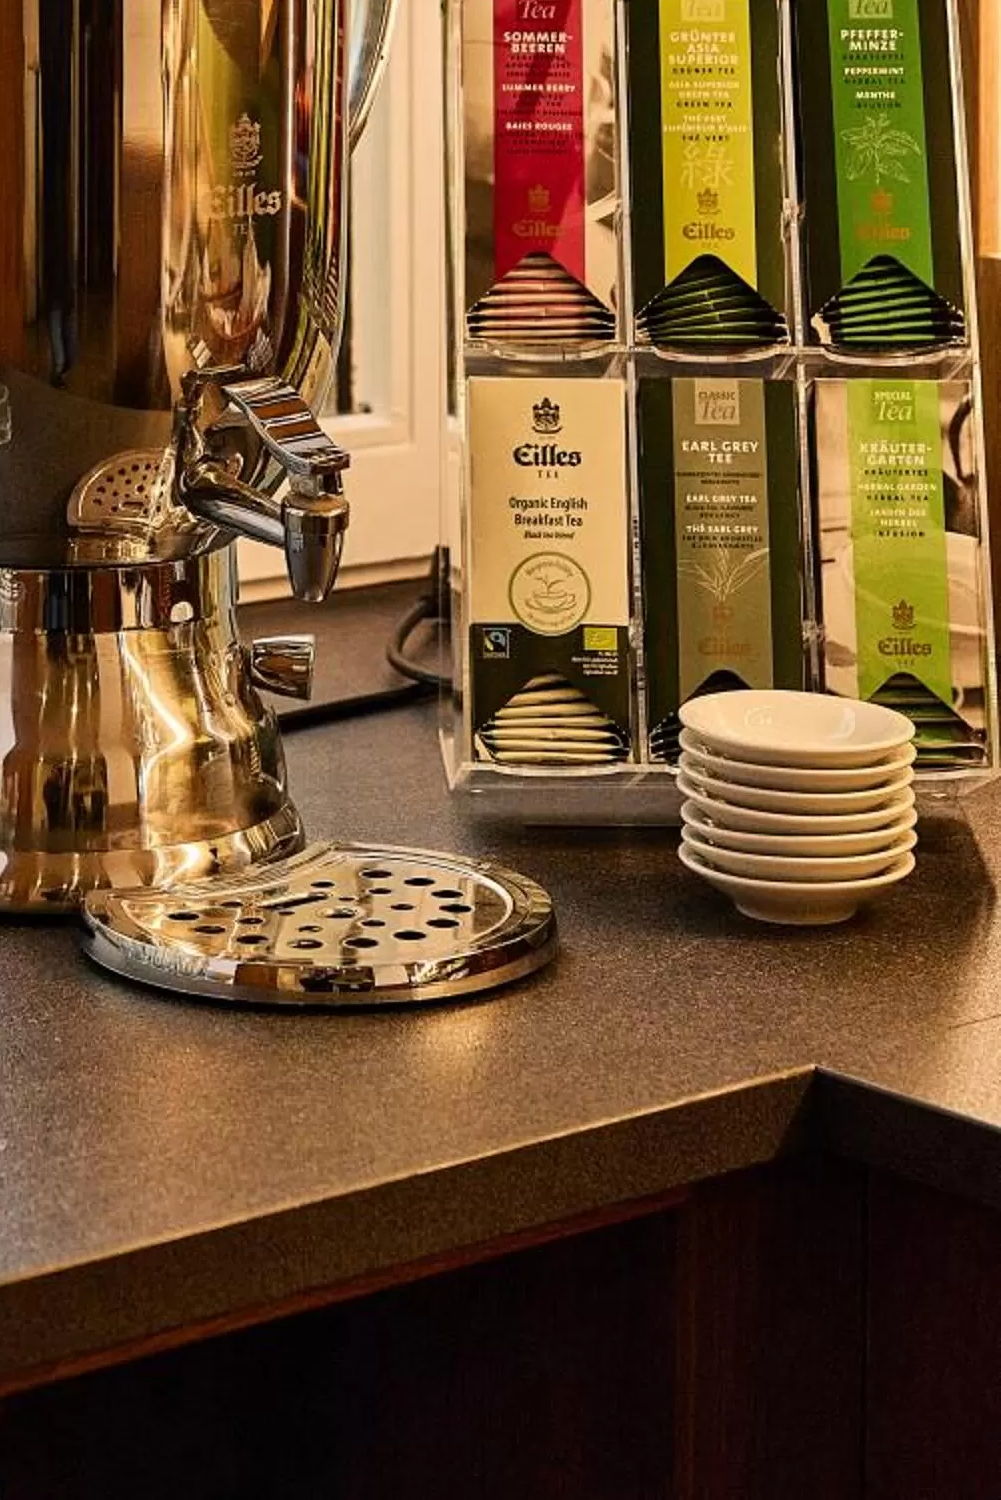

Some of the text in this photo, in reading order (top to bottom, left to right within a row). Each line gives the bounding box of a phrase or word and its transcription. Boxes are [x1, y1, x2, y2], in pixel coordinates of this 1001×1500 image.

[519, 0, 556, 19] Tea
[502, 31, 574, 43] SOMMER-
[840, 29, 904, 40] PFEFFER-
[511, 43, 565, 54] BEEREN
[686, 44, 720, 53] ASIA
[849, 41, 897, 51] MINZE
[668, 54, 739, 65] SUPERIOR
[844, 67, 904, 75] PEPPERMINT
[502, 83, 576, 92] SUMMER BERRY
[855, 91, 896, 99] MENTHE
[505, 122, 532, 131] BAIES
[682, 222, 735, 240] Eilles
[874, 391, 911, 401] SPECIAL
[699, 400, 736, 420] Tea
[875, 401, 912, 421] Tea
[682, 441, 759, 453] EARL GREY
[860, 440, 933, 454] KRÄUTER-
[513, 443, 582, 467] Eilles
[708, 453, 732, 464] TEE
[866, 455, 925, 465] GARTEN
[537, 469, 559, 479] TEE
[686, 494, 758, 503] EARL GREY TEA
[509, 497, 588, 512] Organic English
[514, 513, 584, 527] Breakfast Tea
[708, 525, 731, 533] EARL
[734, 525, 759, 534] GREY
[878, 637, 932, 656] Eilles
